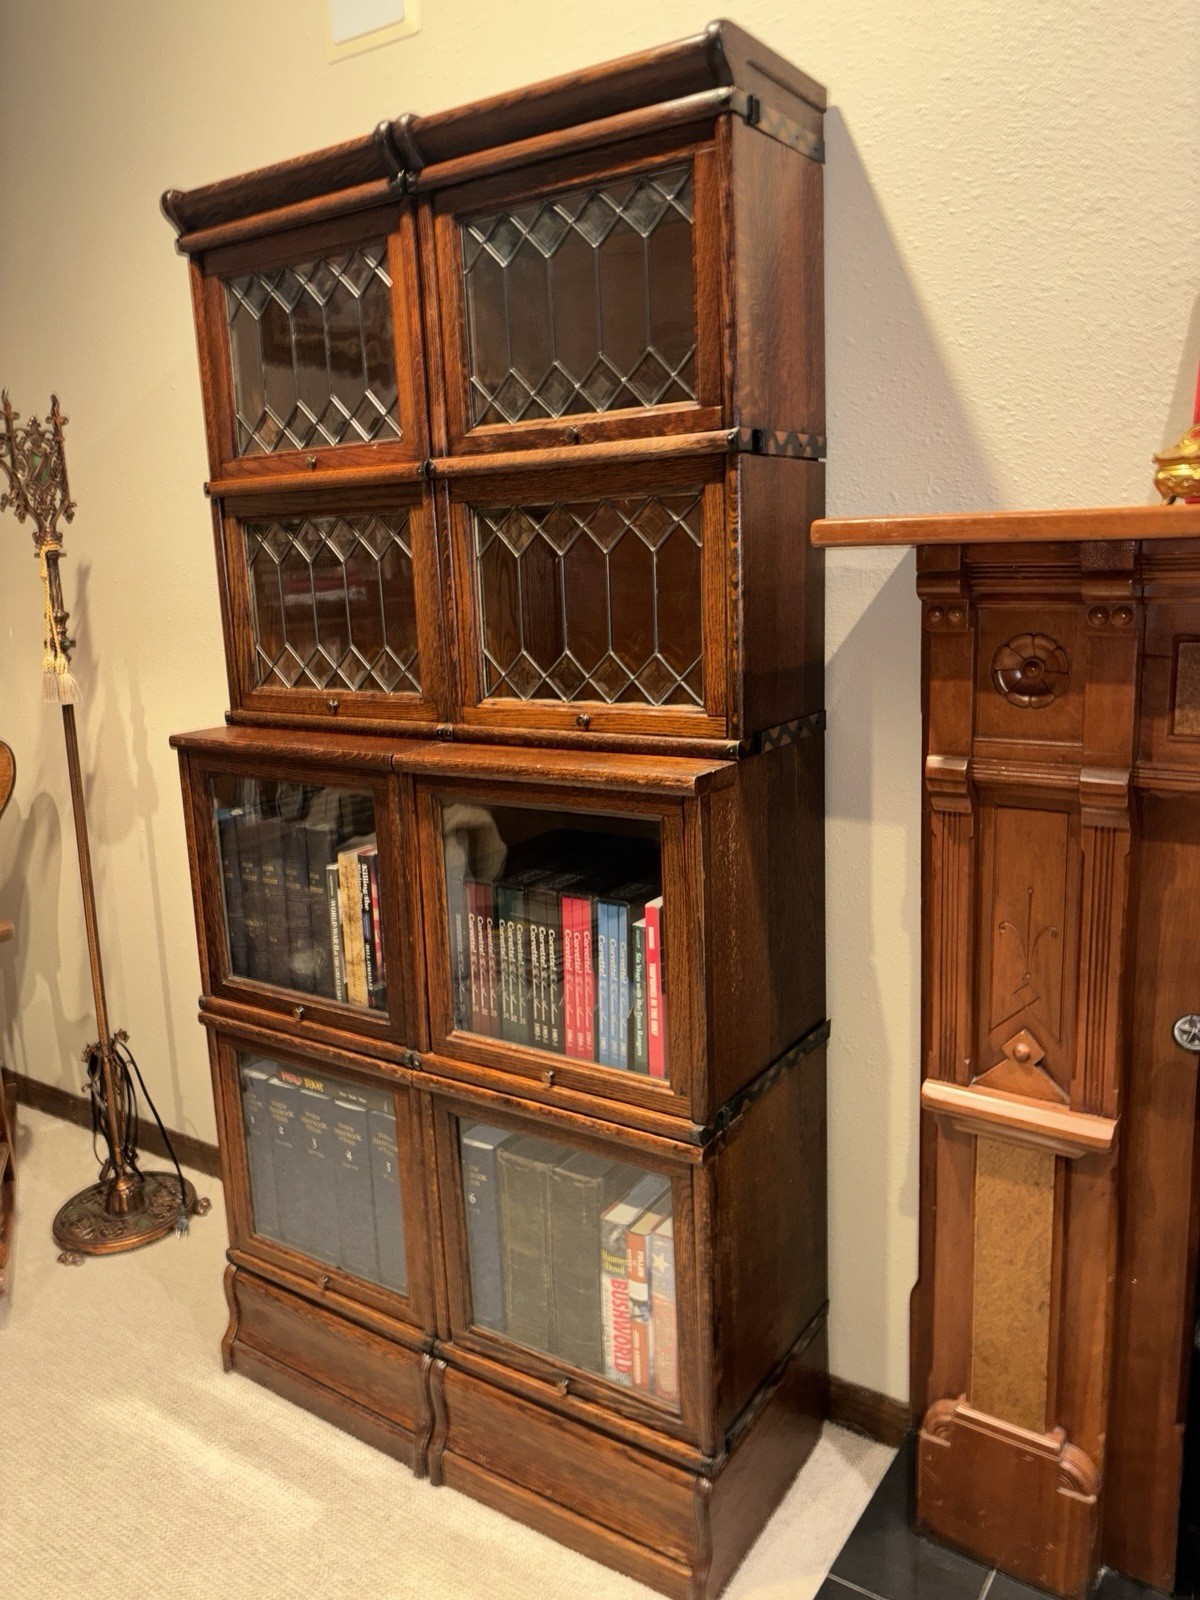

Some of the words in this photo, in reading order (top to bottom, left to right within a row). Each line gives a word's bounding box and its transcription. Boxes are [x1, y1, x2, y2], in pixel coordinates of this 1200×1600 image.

[469, 913, 477, 953] Corvette!
[499, 919, 507, 959] Corvette!
[530, 925, 538, 966] Corvette!
[539, 927, 547, 967] Corvette!
[548, 929, 556, 970] Corvette!
[574, 932, 582, 974] Corvette!
[635, 1030, 643, 1056] Rangers
[278, 1126, 284, 1134] 2
[312, 1137, 317, 1149] 3
[346, 1150, 352, 1161] 4
[386, 1161, 391, 1172] 5
[468, 1193, 476, 1204] 6
[611, 1278, 632, 1374] BUSHWORLD
